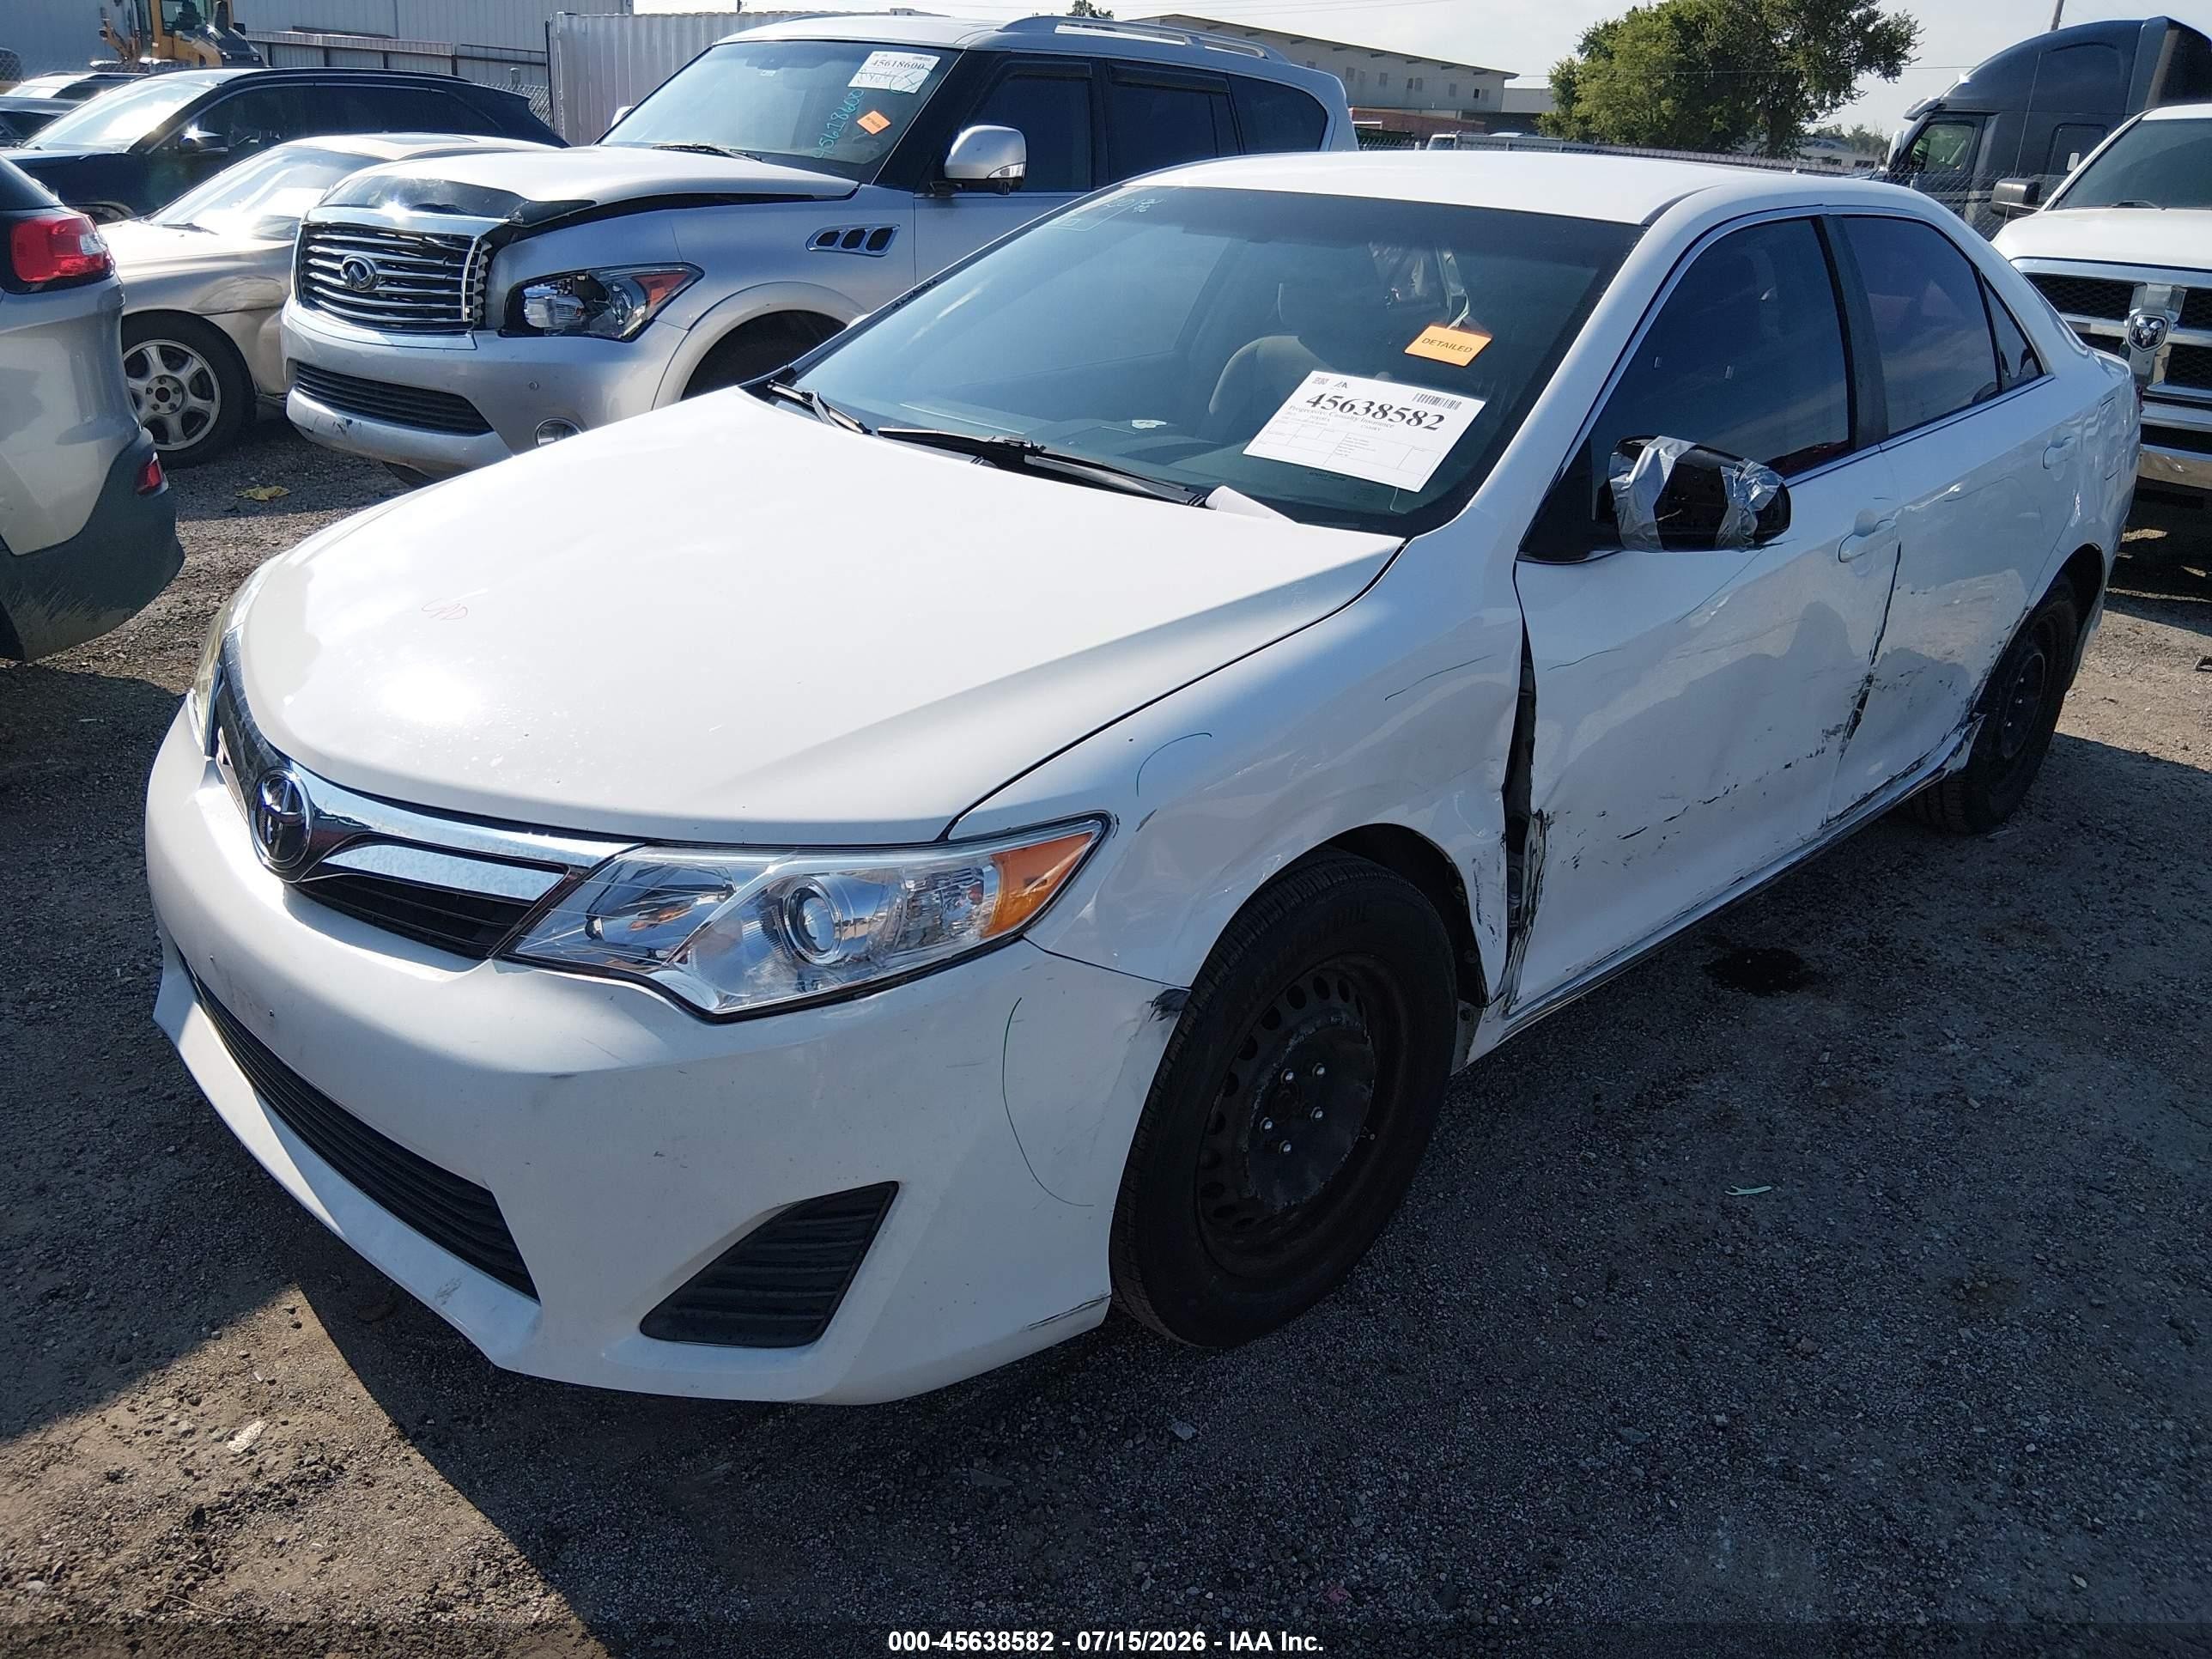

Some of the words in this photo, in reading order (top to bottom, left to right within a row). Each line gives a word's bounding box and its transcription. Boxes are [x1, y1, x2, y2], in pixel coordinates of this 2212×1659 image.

[1421, 337, 1473, 353] DETAILED
[1306, 392, 1444, 431] 45638582
[1329, 411, 1359, 423] Casualty
[1360, 417, 1395, 428] Insurance
